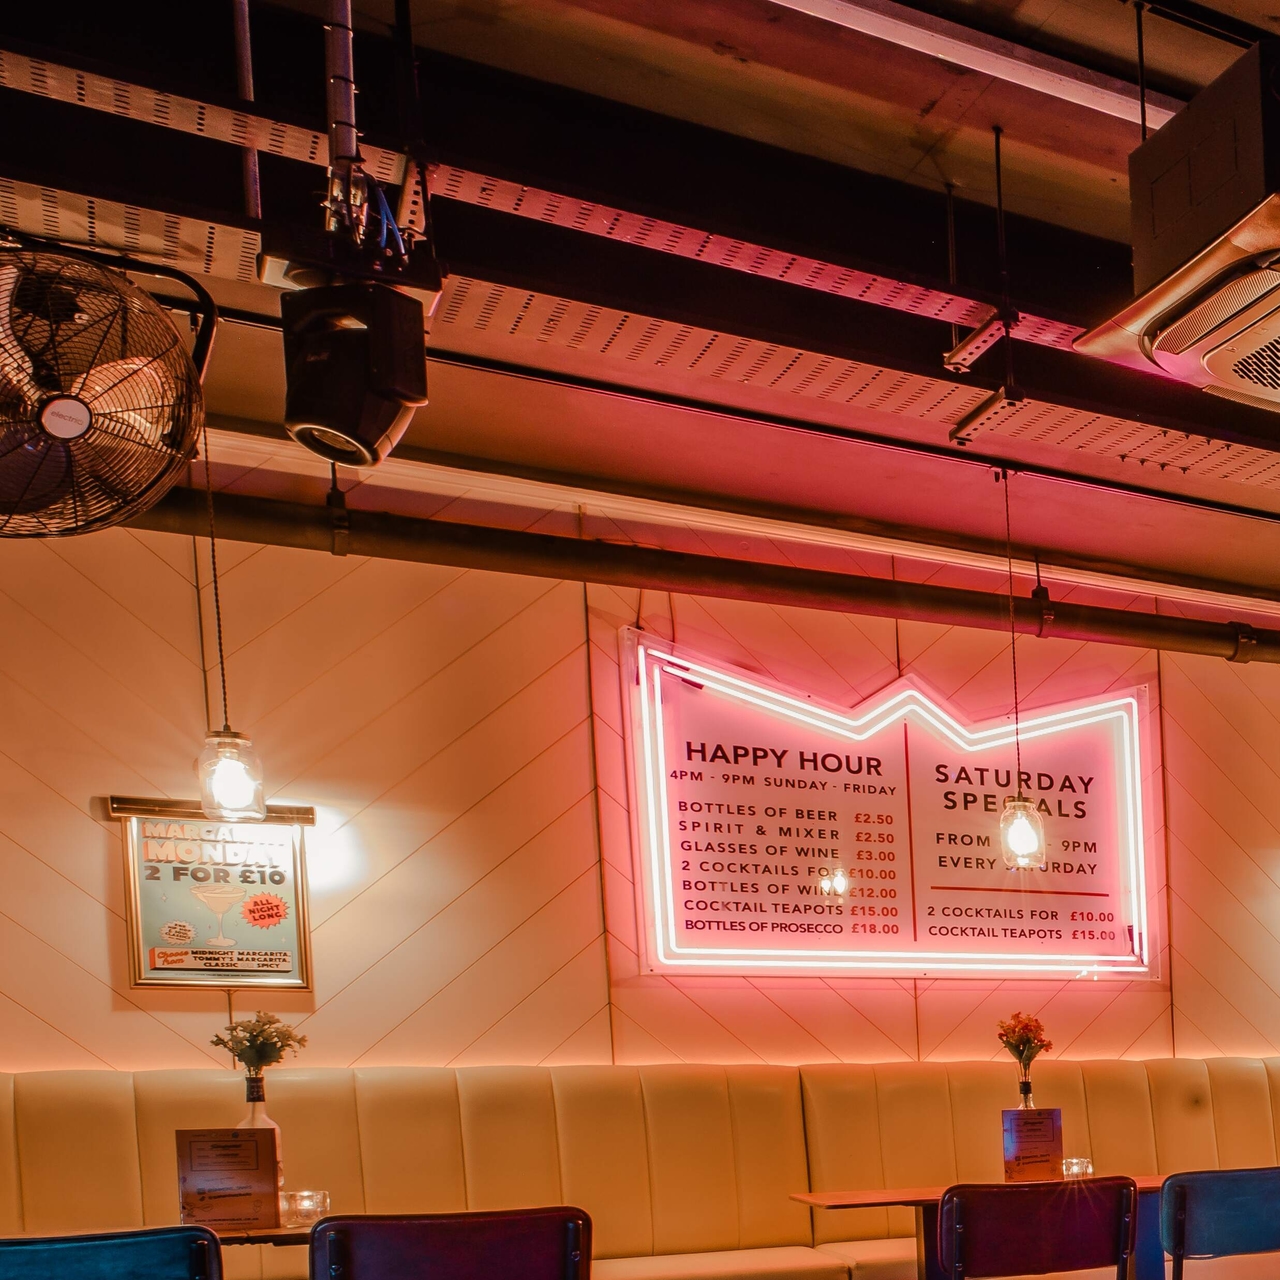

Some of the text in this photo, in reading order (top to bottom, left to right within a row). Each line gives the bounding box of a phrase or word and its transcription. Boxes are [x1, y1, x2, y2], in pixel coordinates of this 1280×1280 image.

[686, 741, 883, 776] HAPPY HOUR
[670, 770, 703, 782] 4PM
[721, 773, 755, 785] 9PM
[764, 776, 828, 791] SUNDAY
[843, 783, 896, 796] FRIDAY
[935, 763, 1095, 794] SATURDAY
[678, 801, 893, 825] BOTTLES OF BEER £2.50
[943, 791, 1086, 819] SPEALS
[678, 820, 895, 844] SPIRIT & MIXER £2.50
[681, 840, 896, 862] GLASSES OF WINE £3.00
[936, 832, 991, 847] FROM
[1061, 840, 1097, 853] 9PM
[144, 865, 161, 881] 2
[173, 866, 230, 883] FOR
[681, 860, 690, 871] 2
[699, 861, 799, 876] COCKTAILS
[849, 869, 896, 880] £10.00
[938, 855, 1097, 875] EVERY URDAY
[682, 880, 759, 893] BOTTLES
[767, 883, 790, 894] OF
[849, 887, 897, 899] £12.00
[248, 904, 280, 915] NIGHT
[253, 899, 273, 907] ALL
[684, 900, 898, 917] COCKTAIL TEAPOTS £15.00
[252, 911, 282, 921] LONG
[927, 906, 1114, 922] 2 COCKTAILS FOR £10.00
[685, 919, 899, 935] BOTTLES OF PROSECCO £18.00
[928, 925, 1116, 940] COCKTAIL TEAPOTS £15.00
[157, 950, 189, 959] Choose
